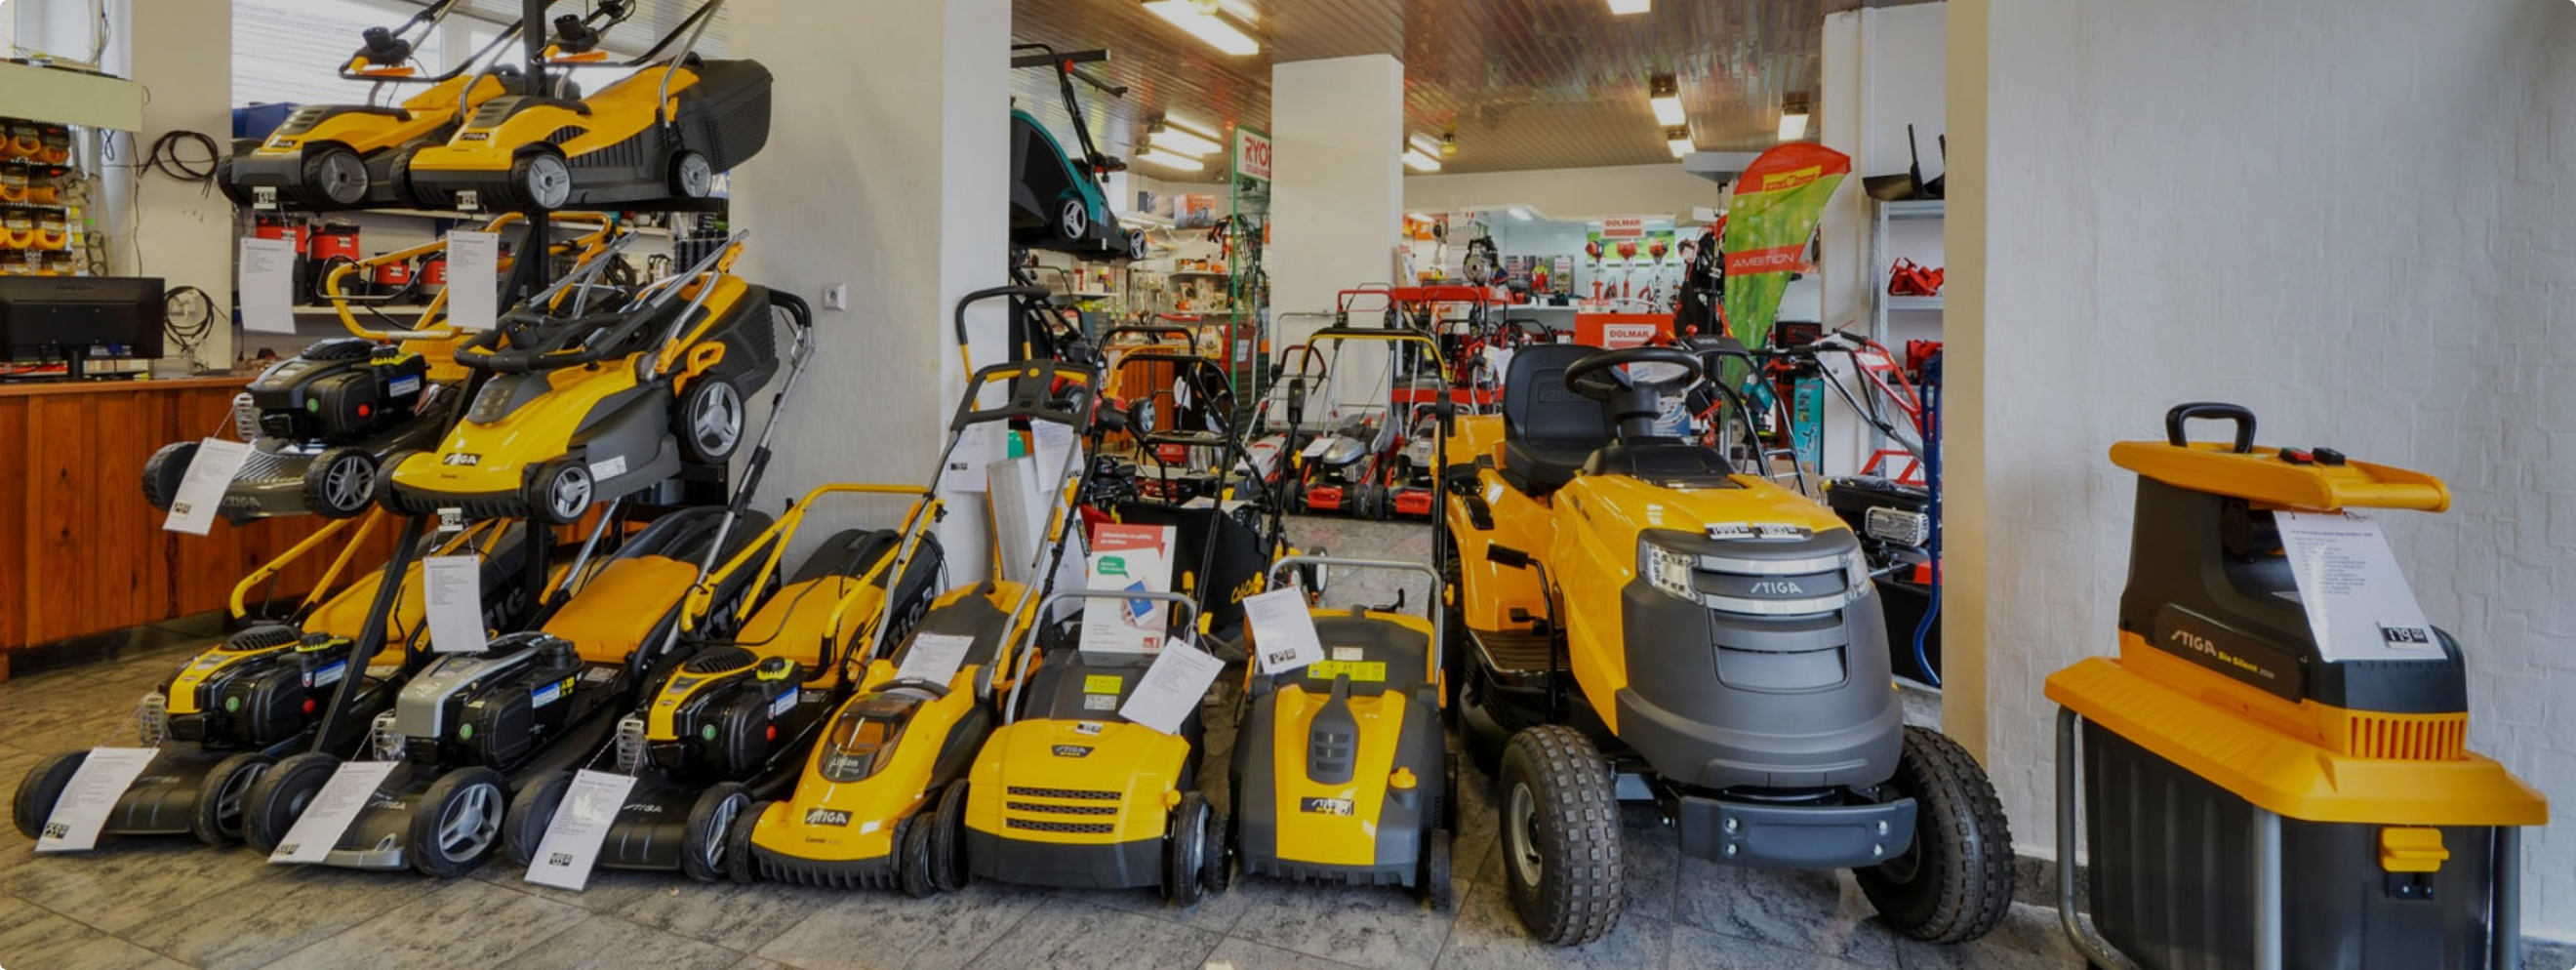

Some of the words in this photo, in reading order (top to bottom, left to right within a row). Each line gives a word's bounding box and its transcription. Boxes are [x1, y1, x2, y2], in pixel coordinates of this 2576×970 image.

[1244, 135, 1271, 169] RYO
[1604, 219, 1641, 227] DOLMAR
[1733, 253, 1795, 267] AMBITION
[1609, 330, 1650, 339] DOLMAR
[1751, 581, 1803, 594] STIGA
[2388, 627, 2411, 642] 179
[2170, 629, 2217, 657] STIGA
[2232, 656, 2258, 673] Silent
[806, 809, 847, 824] STIGA
